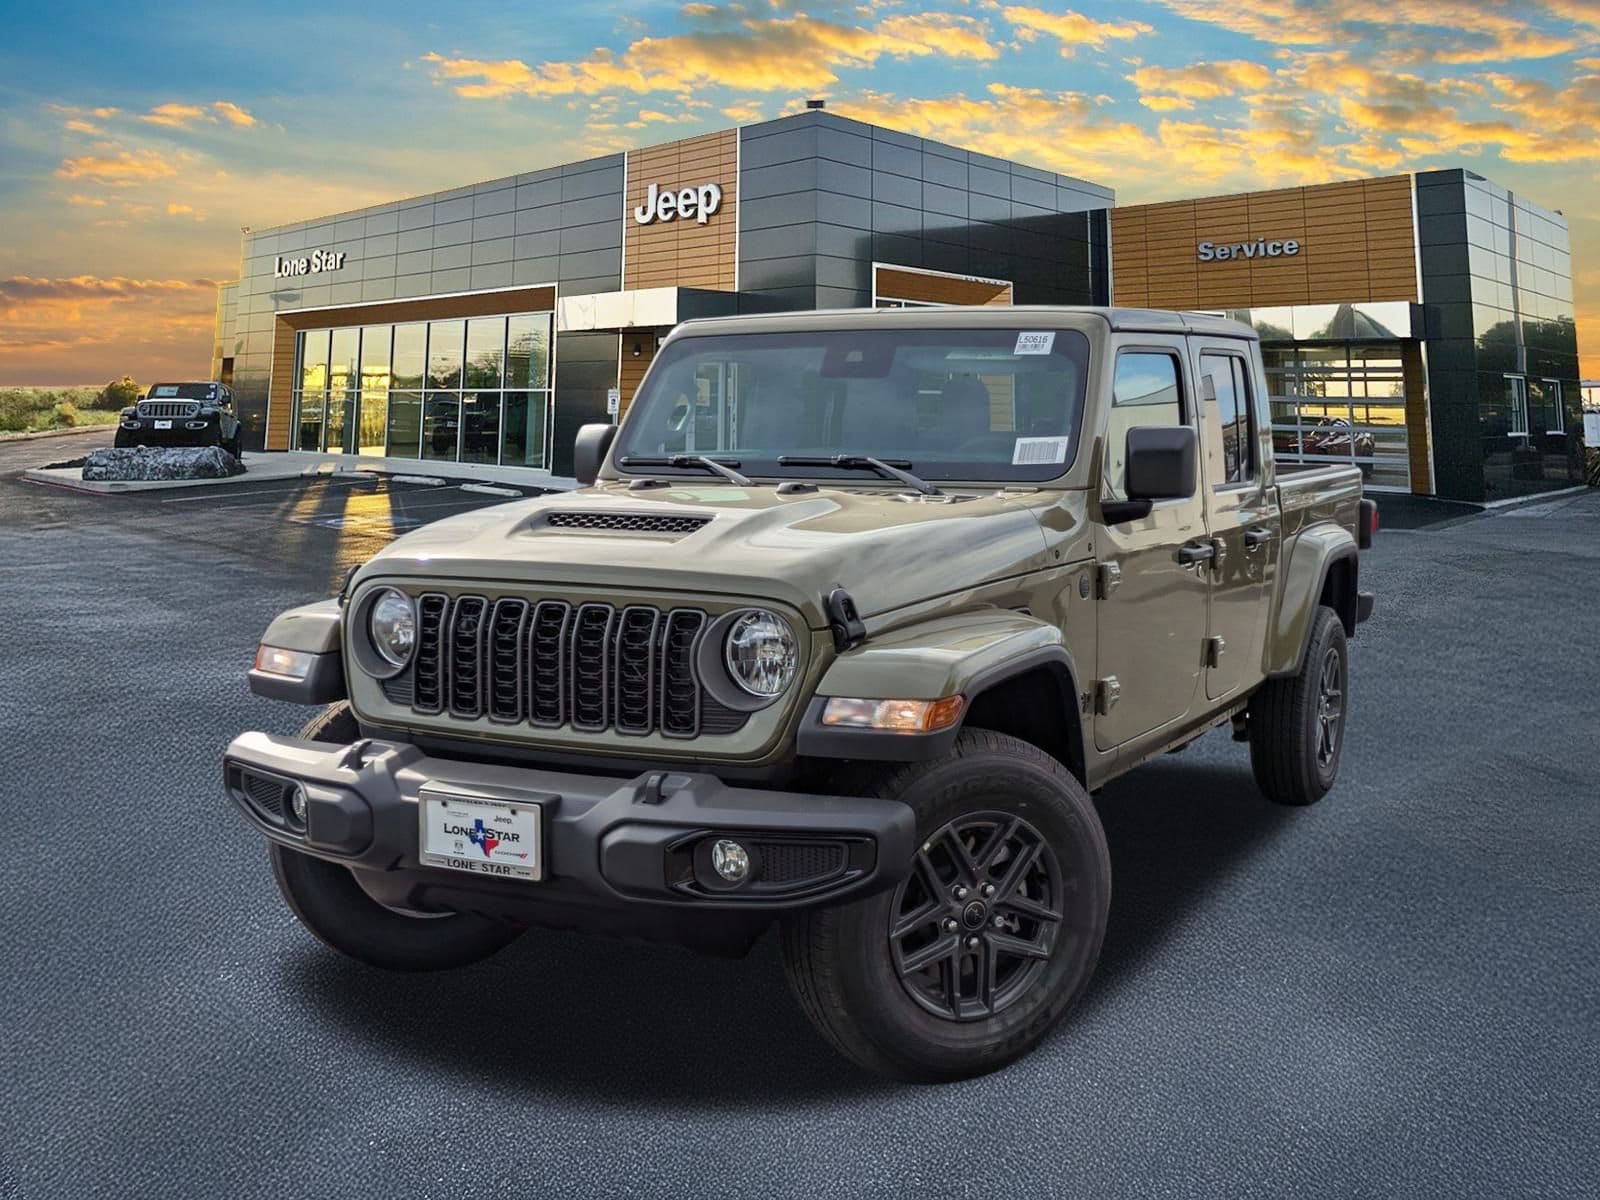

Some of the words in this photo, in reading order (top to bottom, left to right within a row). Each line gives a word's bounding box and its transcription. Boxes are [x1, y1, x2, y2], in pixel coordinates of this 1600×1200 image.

[634, 183, 722, 225] Jeep
[1198, 237, 1299, 262] Service
[275, 257, 310, 278] Lone
[312, 249, 346, 273] Star
[494, 815, 513, 825] Jeep
[443, 823, 475, 837] LONE
[485, 828, 520, 842] STAR
[447, 858, 477, 870] LONE
[481, 864, 511, 875] STAR
